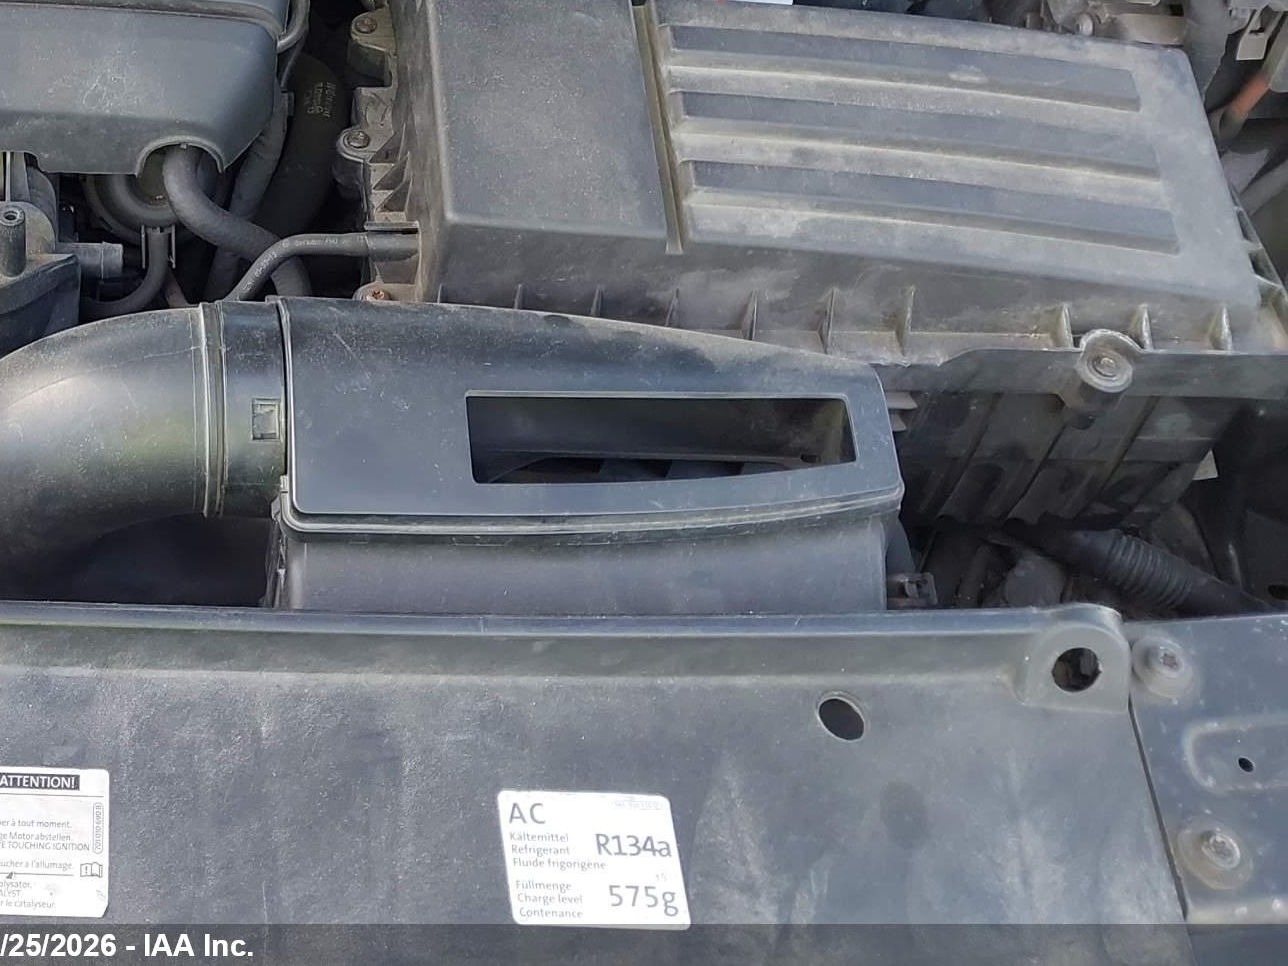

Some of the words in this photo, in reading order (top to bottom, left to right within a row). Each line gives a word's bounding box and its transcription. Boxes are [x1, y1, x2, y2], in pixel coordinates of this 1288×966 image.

[0, 774, 75, 789] ATTENTION!
[509, 803, 546, 824] AC
[36, 821, 72, 829] moment.
[9, 832, 34, 840] Motor
[510, 832, 569, 842] Kältemittel
[8, 841, 50, 850] TOUCHING
[53, 842, 90, 851] IGNITION
[511, 845, 570, 857] Refrigerant
[596, 834, 672, 857] R134a
[513, 858, 545, 867] Fluide
[516, 879, 572, 893] Füllmenge
[517, 893, 555, 905] Charge
[558, 894, 583, 903] level
[609, 885, 679, 916] 575g
[520, 907, 583, 918] Contenance
